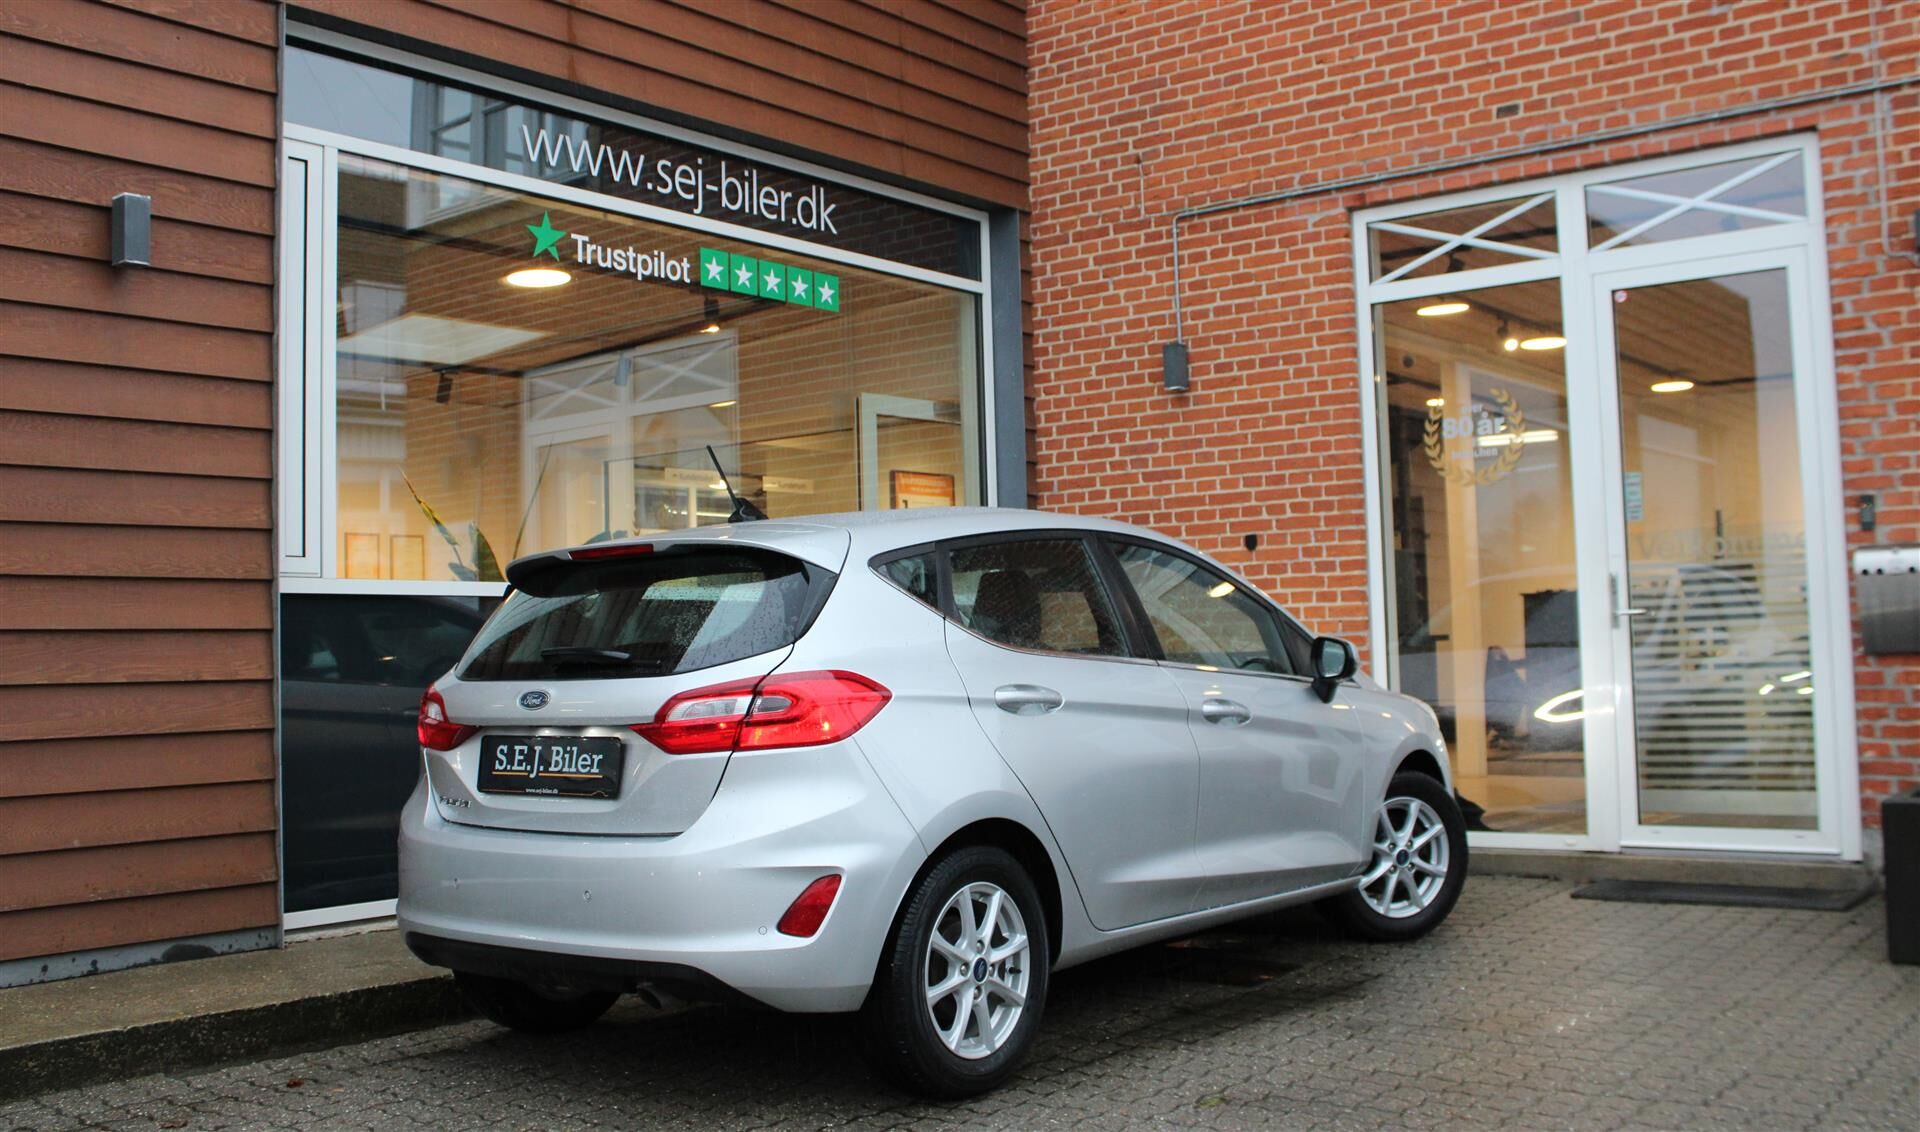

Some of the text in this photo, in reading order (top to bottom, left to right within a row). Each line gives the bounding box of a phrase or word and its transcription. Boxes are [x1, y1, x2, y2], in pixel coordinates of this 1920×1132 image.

[521, 124, 838, 235] www.sej-biler.dk
[570, 232, 692, 284] Trustpilot
[495, 745, 603, 778] S.E.J. Biler
